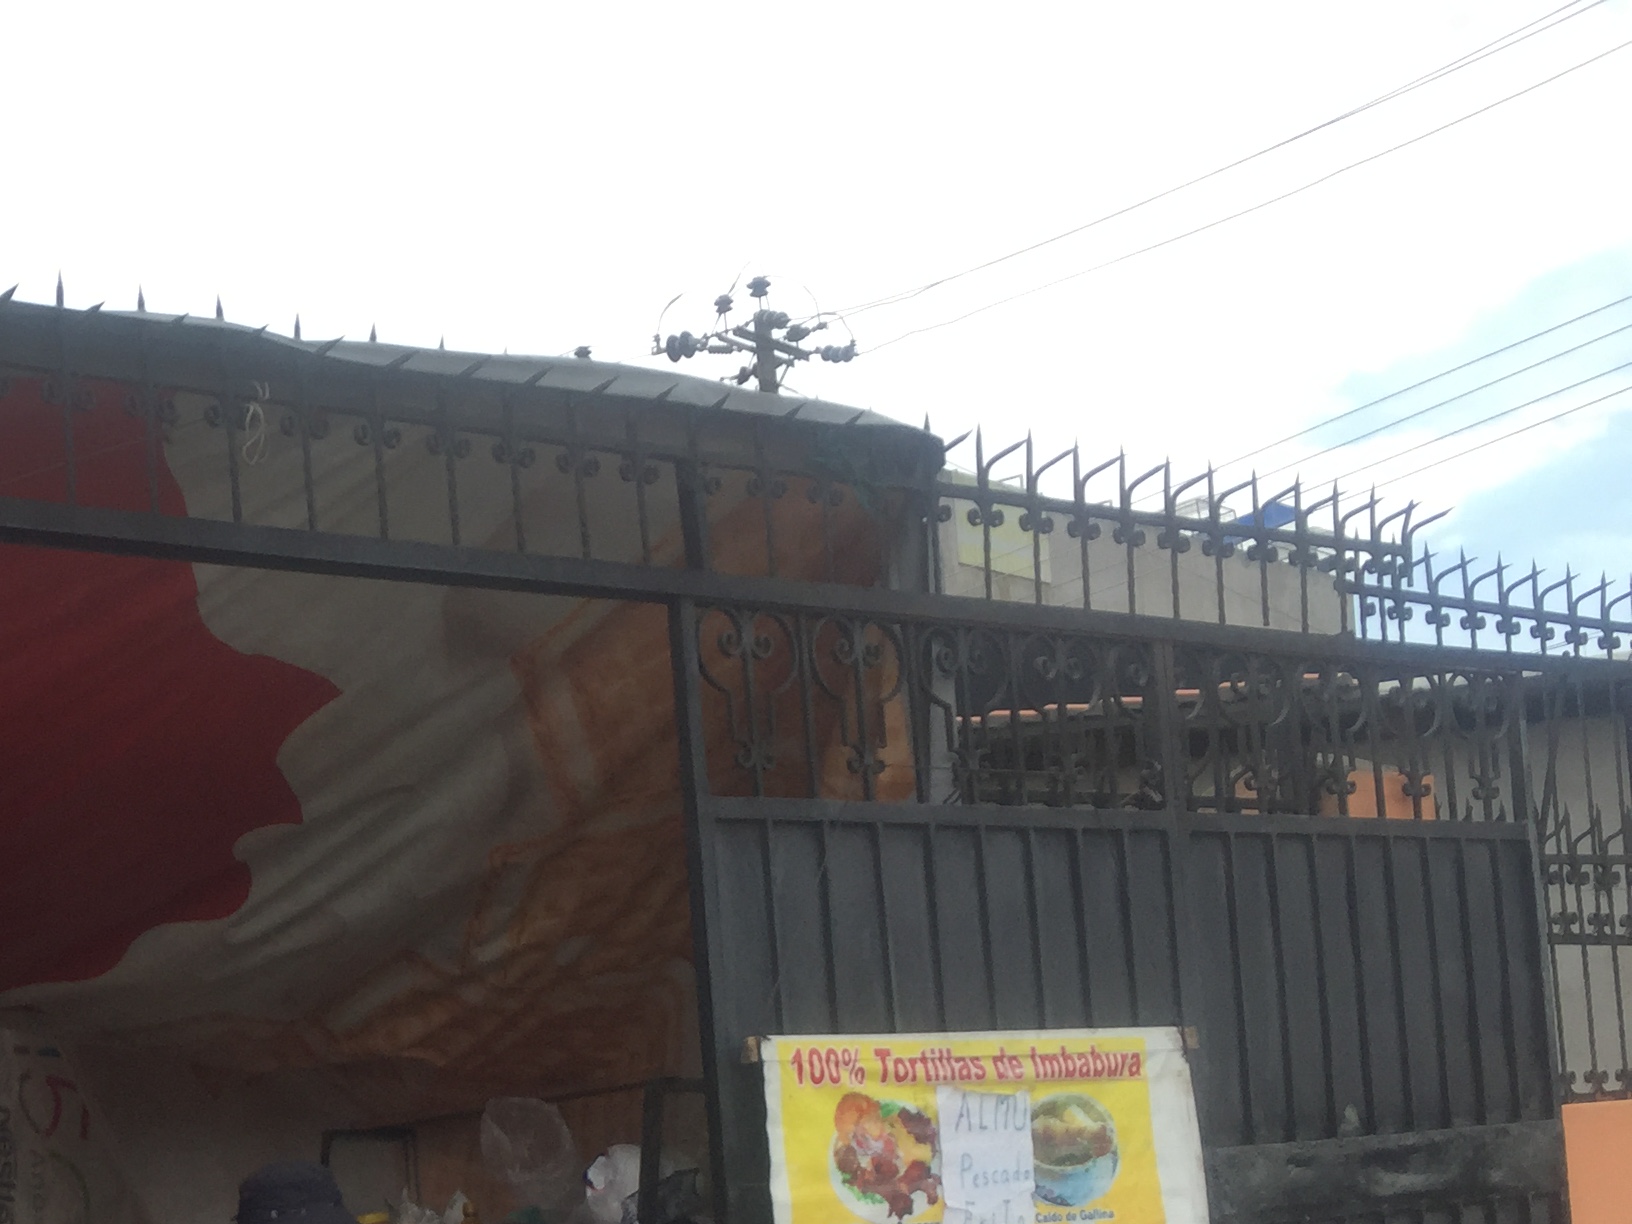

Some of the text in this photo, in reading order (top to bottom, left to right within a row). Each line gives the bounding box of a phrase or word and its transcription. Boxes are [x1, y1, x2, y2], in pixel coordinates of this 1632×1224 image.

[791, 1044, 1141, 1085] 100% Tortillas de Imbabura
[954, 1092, 1027, 1132] ALMU
[959, 1151, 1031, 1189] Pescado
[1035, 1208, 1114, 1223] Caldo de Gallina
